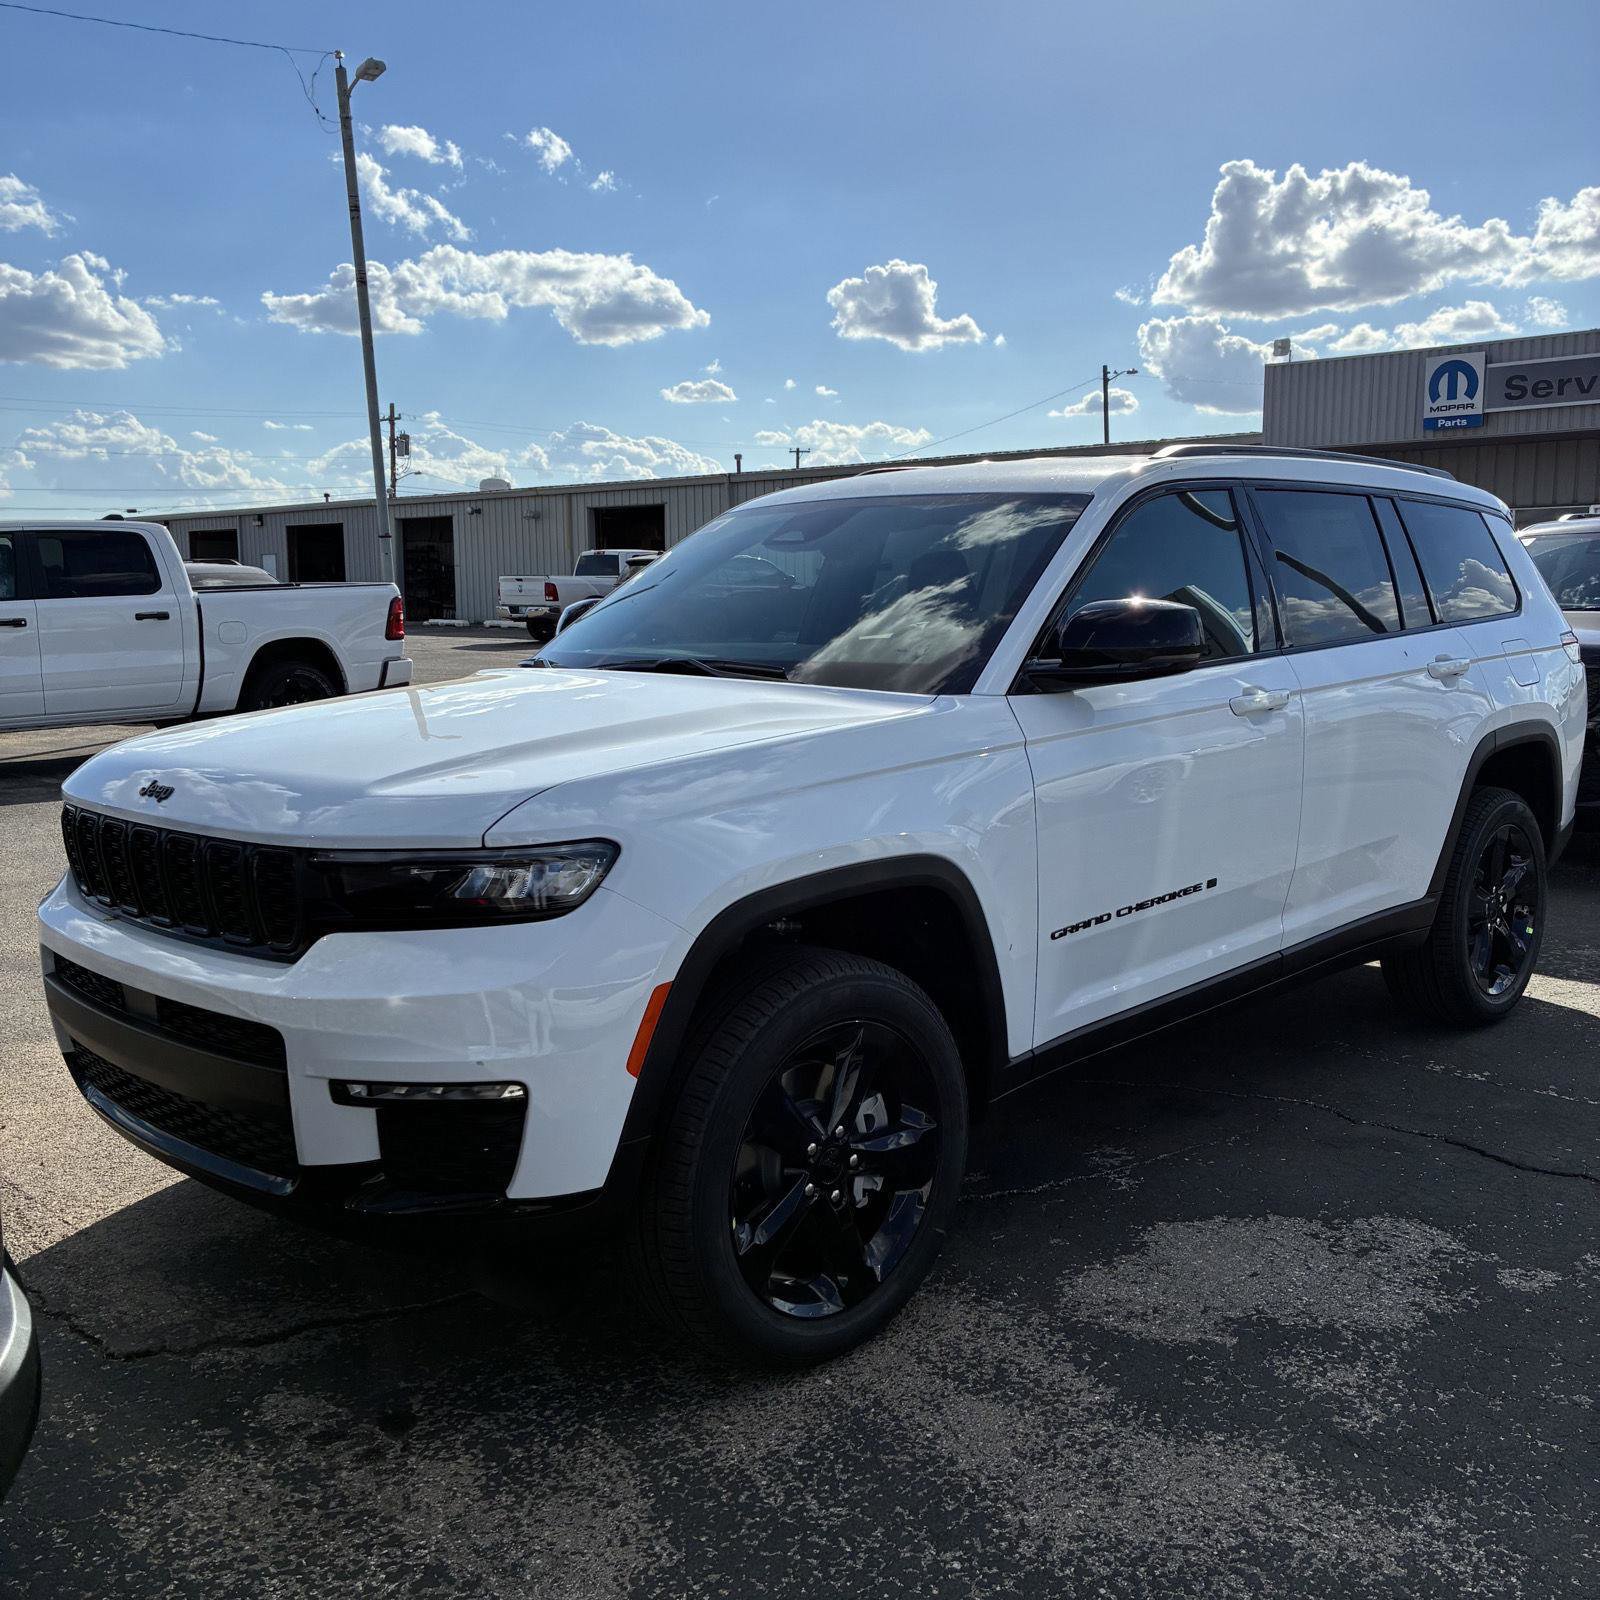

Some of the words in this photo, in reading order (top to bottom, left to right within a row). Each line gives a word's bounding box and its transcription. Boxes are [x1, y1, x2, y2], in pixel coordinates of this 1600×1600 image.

[1429, 402, 1476, 413] MOPAR
[1437, 418, 1467, 428] Parts
[139, 780, 175, 803] Jeep
[1050, 912, 1112, 941] GRAND
[1116, 882, 1204, 918] CHEROKEE
